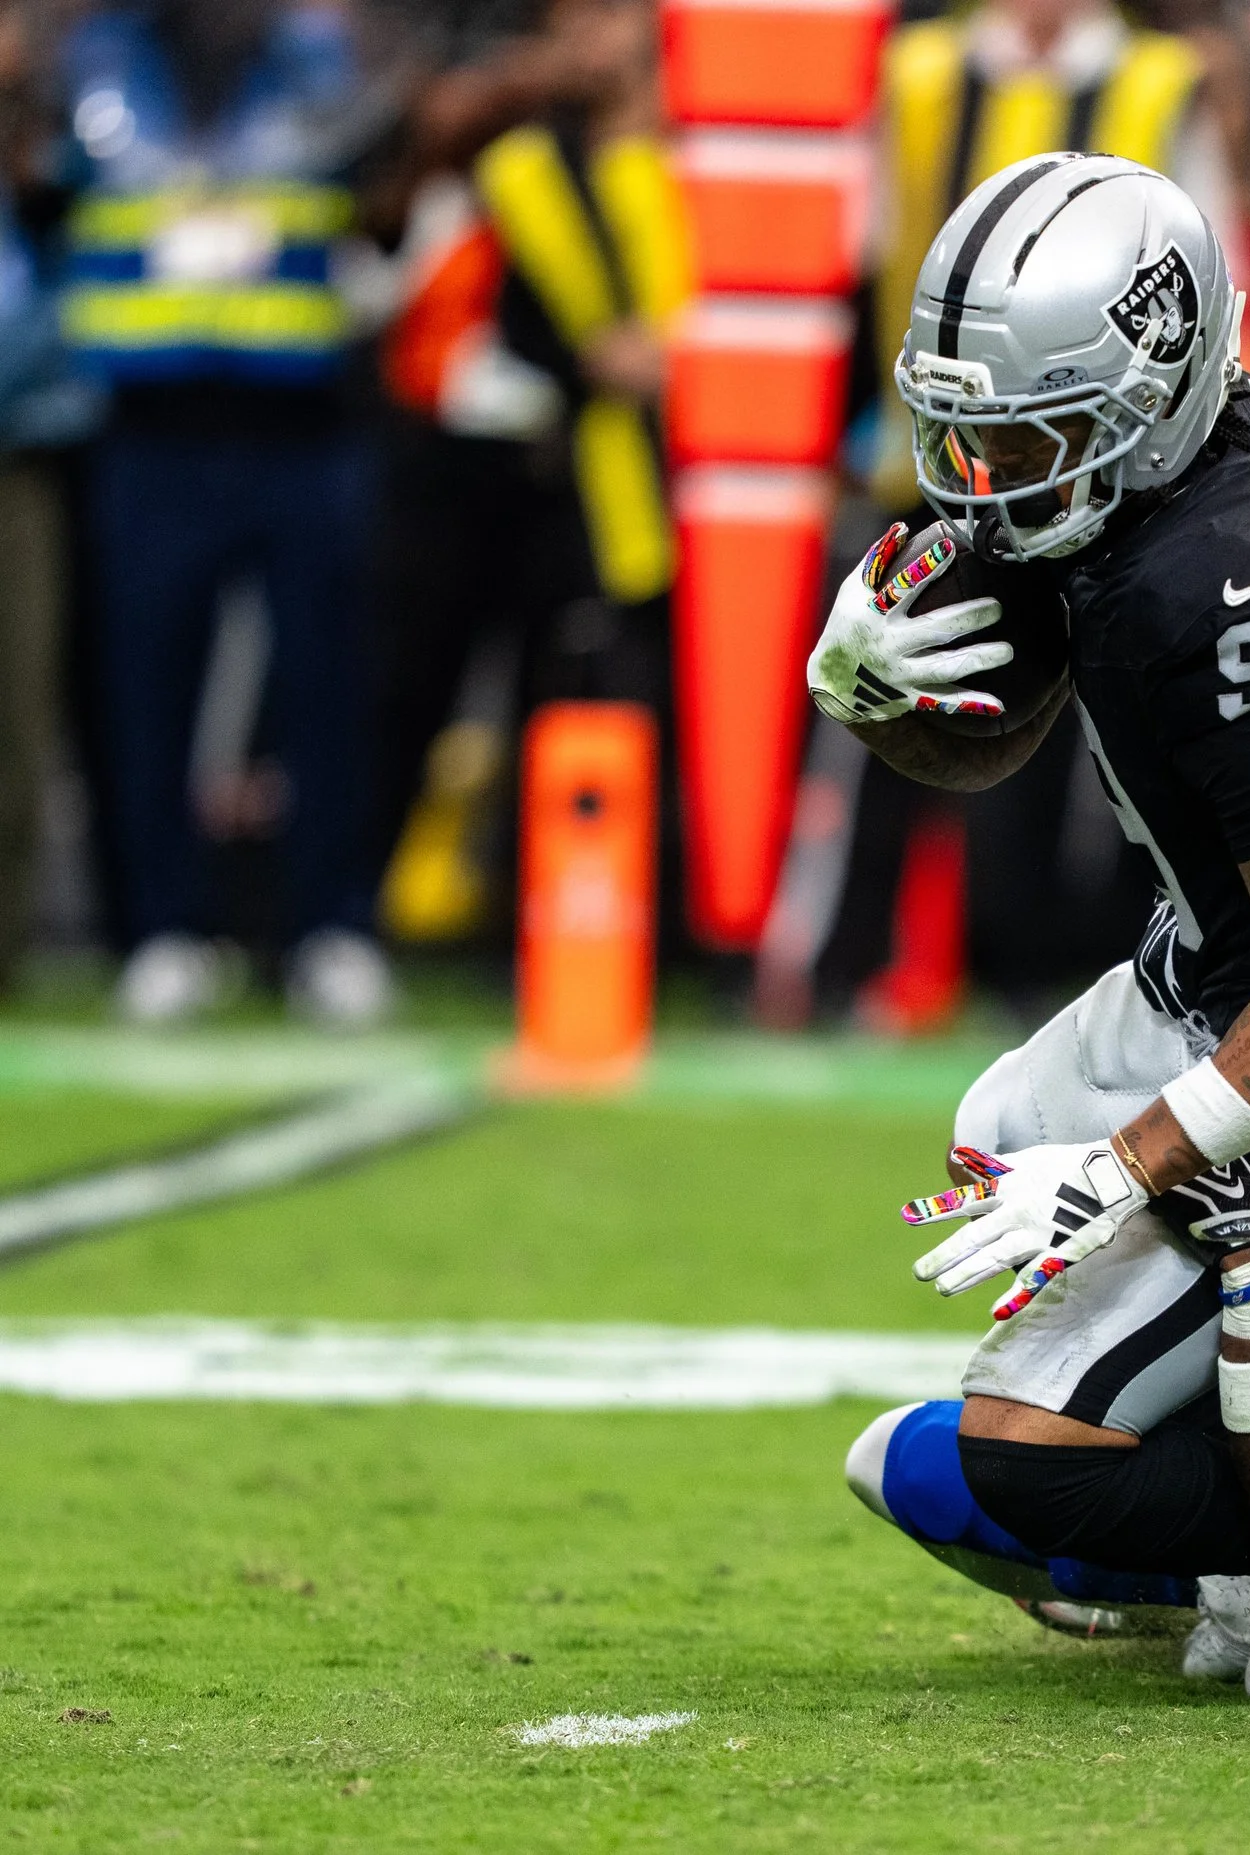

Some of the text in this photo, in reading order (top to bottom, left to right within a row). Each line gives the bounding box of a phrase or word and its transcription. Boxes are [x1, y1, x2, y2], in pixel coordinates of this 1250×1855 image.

[1116, 254, 1176, 316] RAIDERS
[930, 369, 962, 385] RAIDERS
[1037, 375, 1084, 391] OAKLEY
